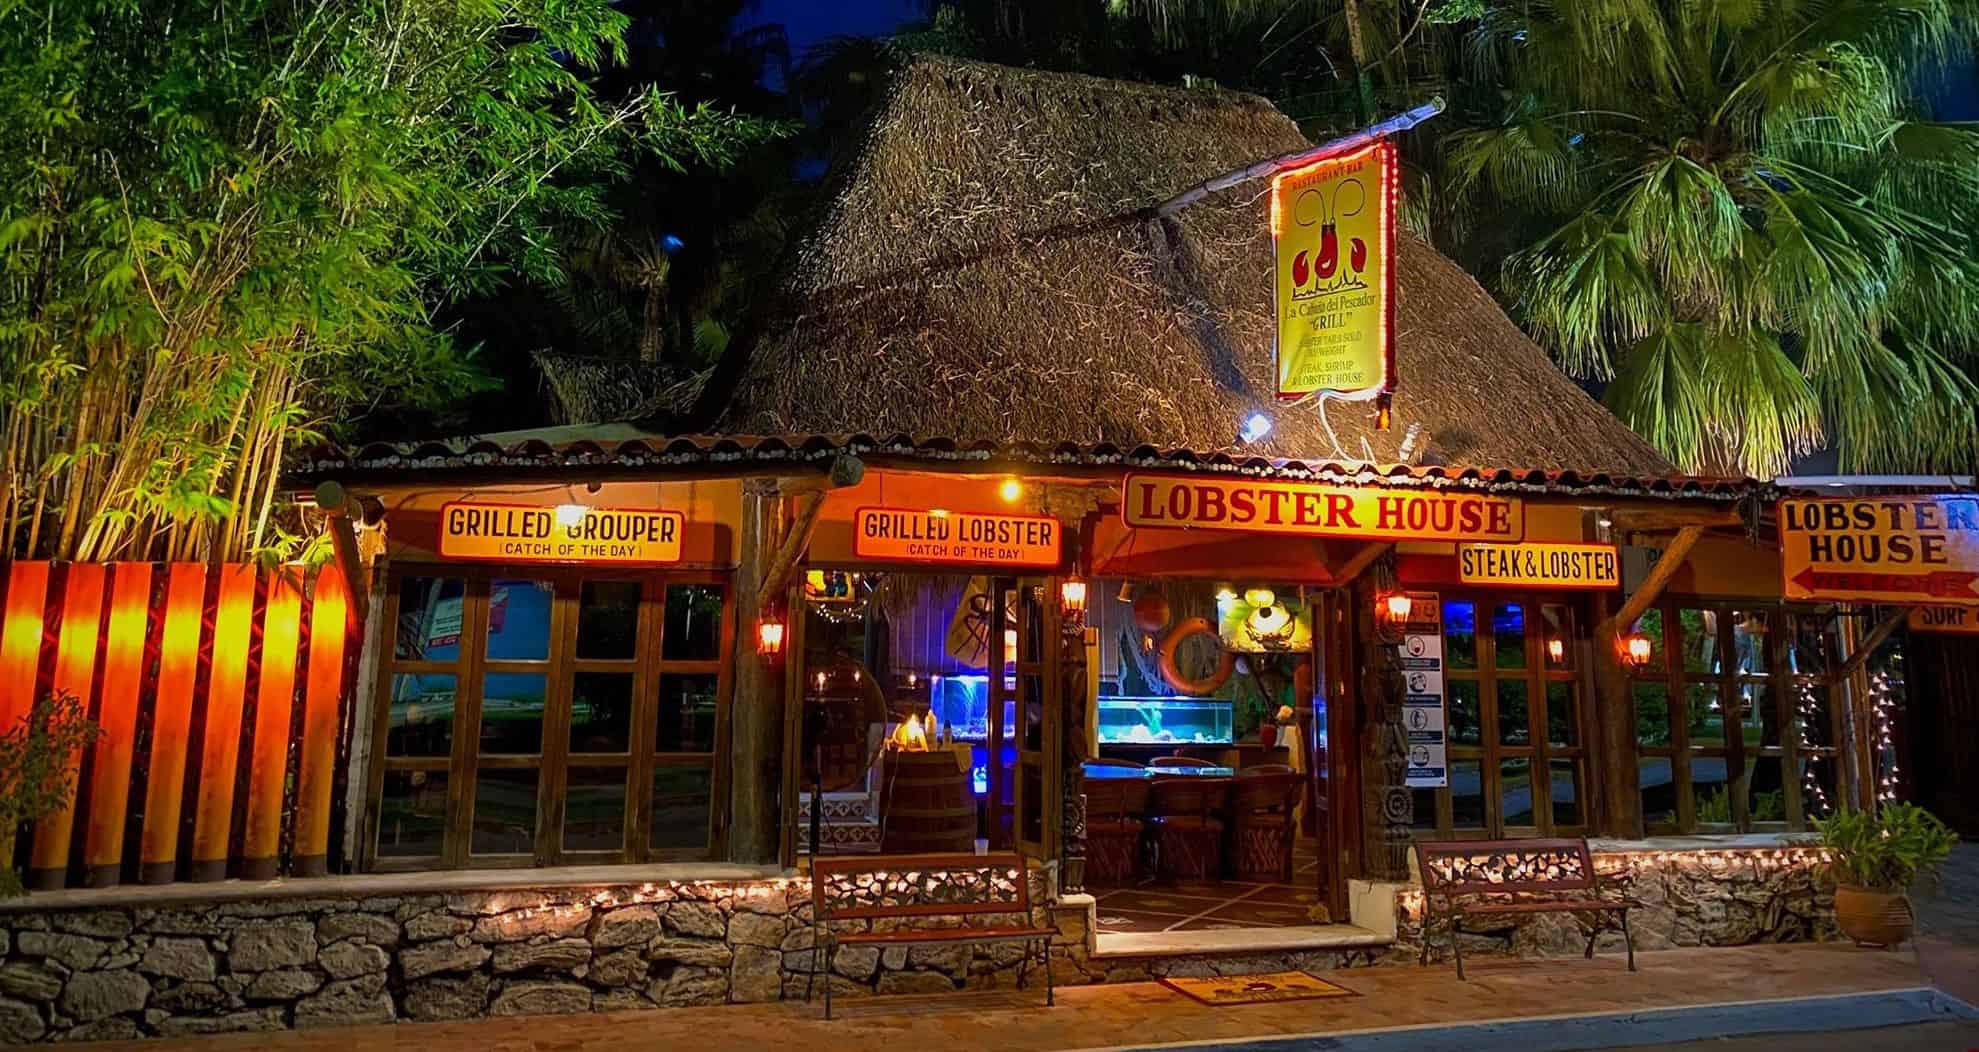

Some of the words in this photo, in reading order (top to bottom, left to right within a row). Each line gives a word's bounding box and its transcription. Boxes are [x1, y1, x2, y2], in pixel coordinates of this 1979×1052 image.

[1285, 306, 1296, 319] La
[1327, 297, 1337, 311] del
[1340, 292, 1376, 310] Pescador
[1325, 360, 1353, 372] SHRIMP
[1335, 372, 1363, 384] HOUSE
[1138, 483, 1360, 529] LOBSTER
[1375, 495, 1511, 535] HOUSE
[1785, 502, 1979, 531] LOBSTER
[449, 508, 551, 538] GRILLED
[566, 513, 675, 543] GROUPER
[864, 512, 949, 541] GRILLED
[959, 517, 1052, 546] LOBSTER
[558, 544, 575, 555] OF
[582, 544, 606, 556] THE
[953, 544, 967, 557] OF
[972, 546, 995, 559] THE
[1809, 534, 1948, 564] HOUSE
